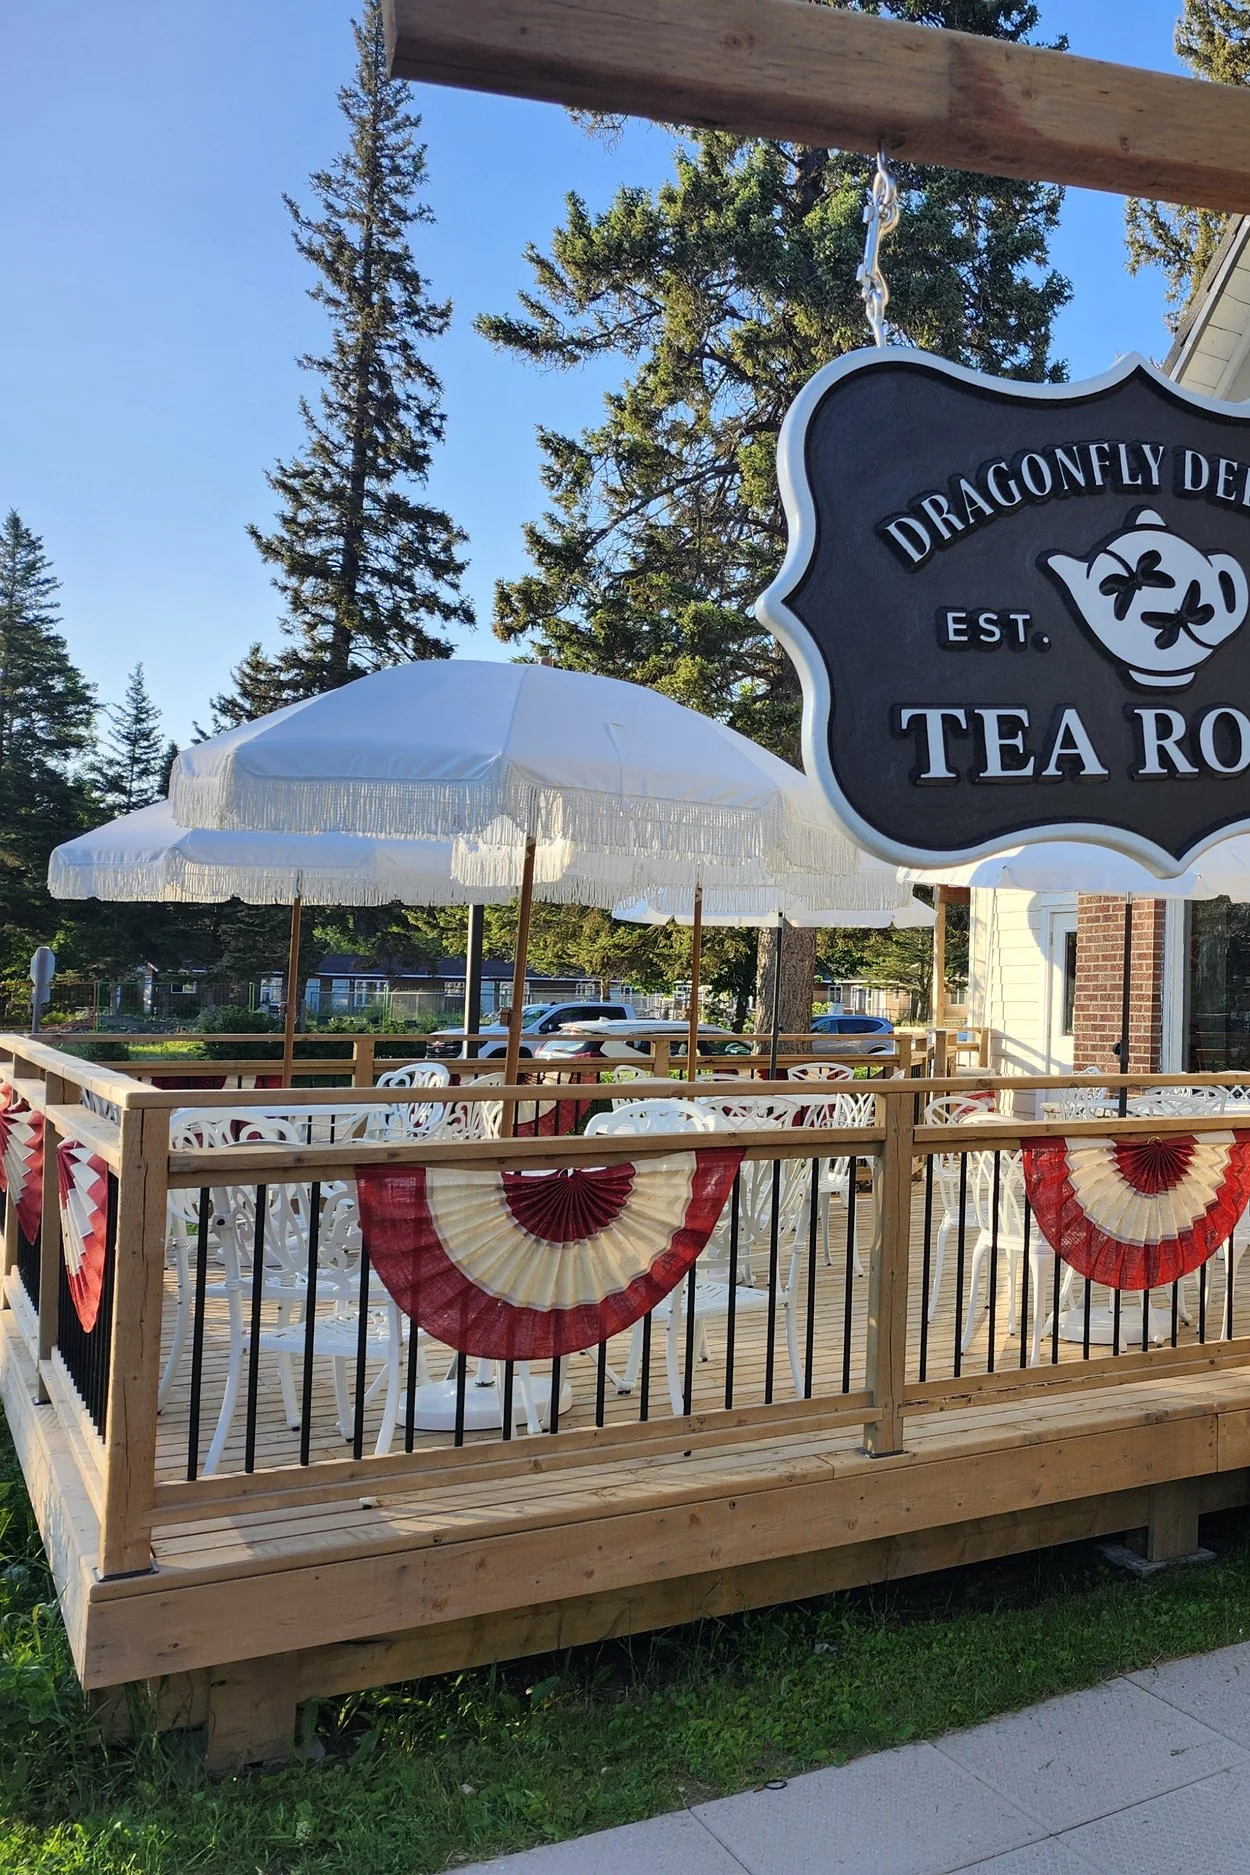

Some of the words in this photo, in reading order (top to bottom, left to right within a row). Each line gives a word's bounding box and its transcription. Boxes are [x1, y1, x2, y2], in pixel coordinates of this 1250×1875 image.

[885, 443, 1165, 563] DRAGONFLY
[946, 612, 1050, 643] EST.
[900, 708, 1109, 779] TEA
